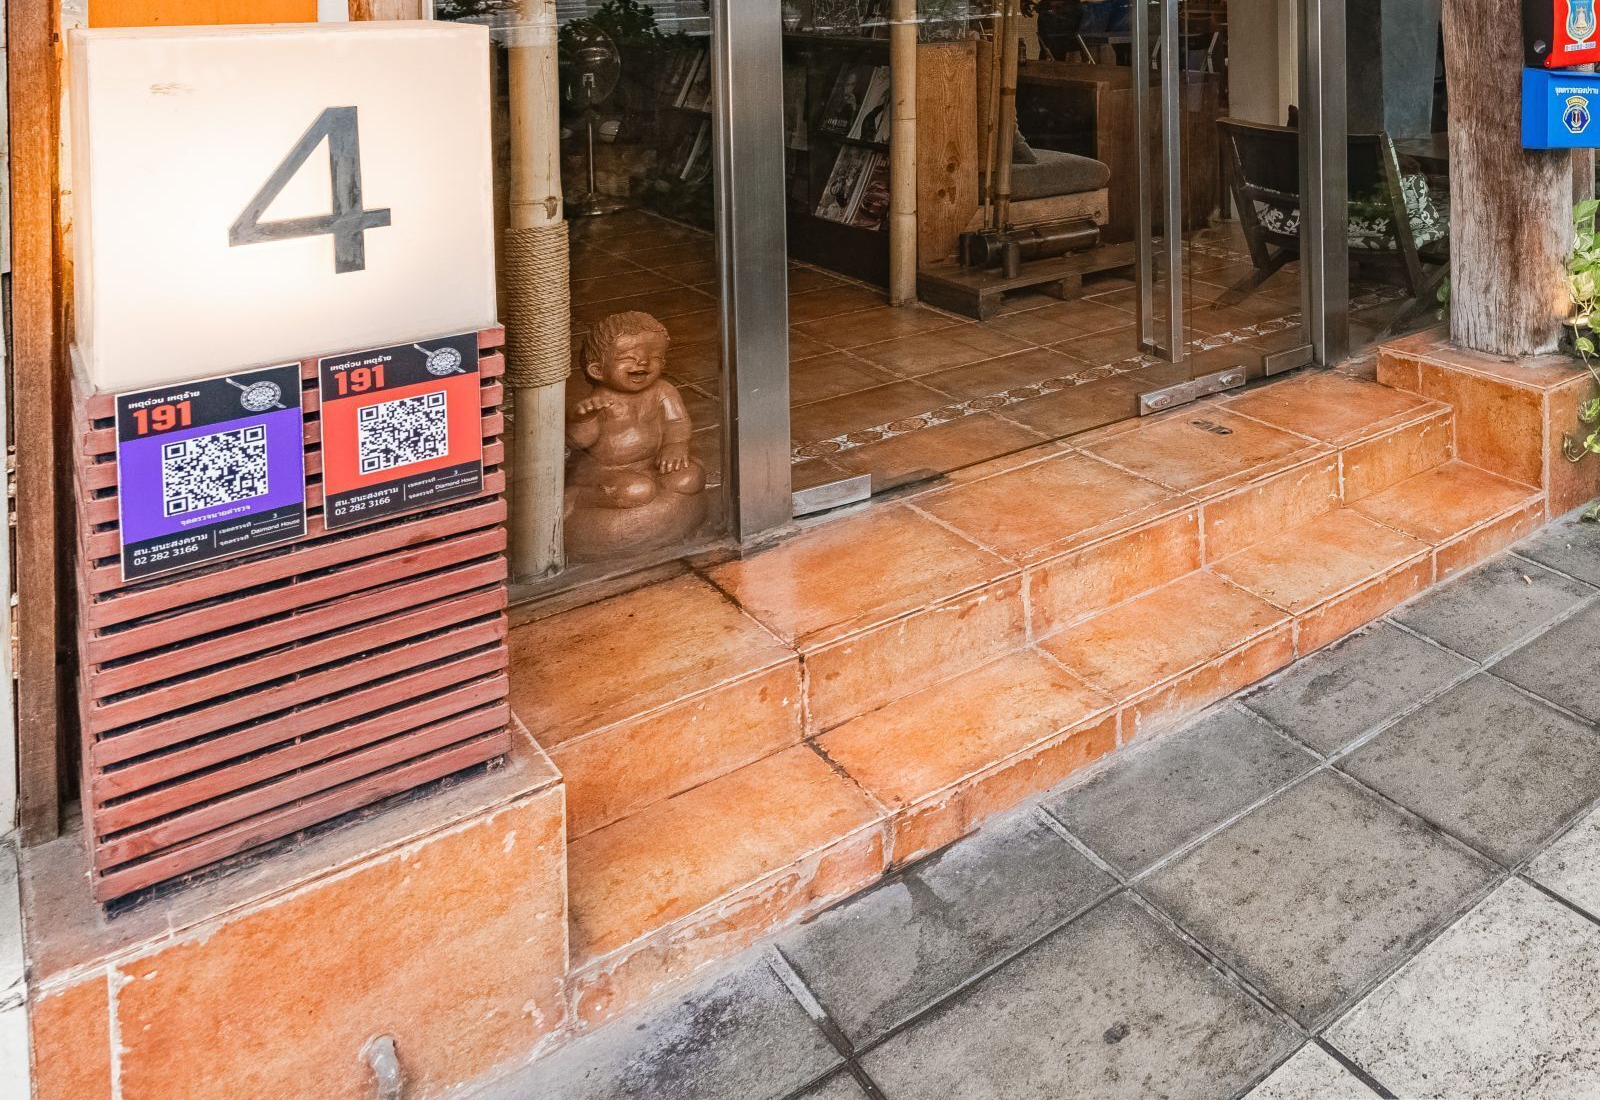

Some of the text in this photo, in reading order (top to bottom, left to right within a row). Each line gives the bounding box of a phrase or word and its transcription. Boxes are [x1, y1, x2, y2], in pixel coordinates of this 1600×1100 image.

[228, 106, 392, 275] 4
[330, 354, 392, 371] เหตุด่วน เหตุร้าย
[334, 364, 385, 396] 191
[128, 389, 201, 410] เหตุด่วน เหตุร้าย
[133, 401, 193, 436] 191
[435, 479, 460, 491] Diamond
[461, 474, 479, 485] House
[334, 486, 399, 507] สน.ชนะสงคราม
[335, 496, 391, 517] 02 282 3166
[281, 518, 301, 529] House
[133, 533, 209, 556] สน.ชนะสงคราม
[133, 543, 199, 567] 02 282 3166
